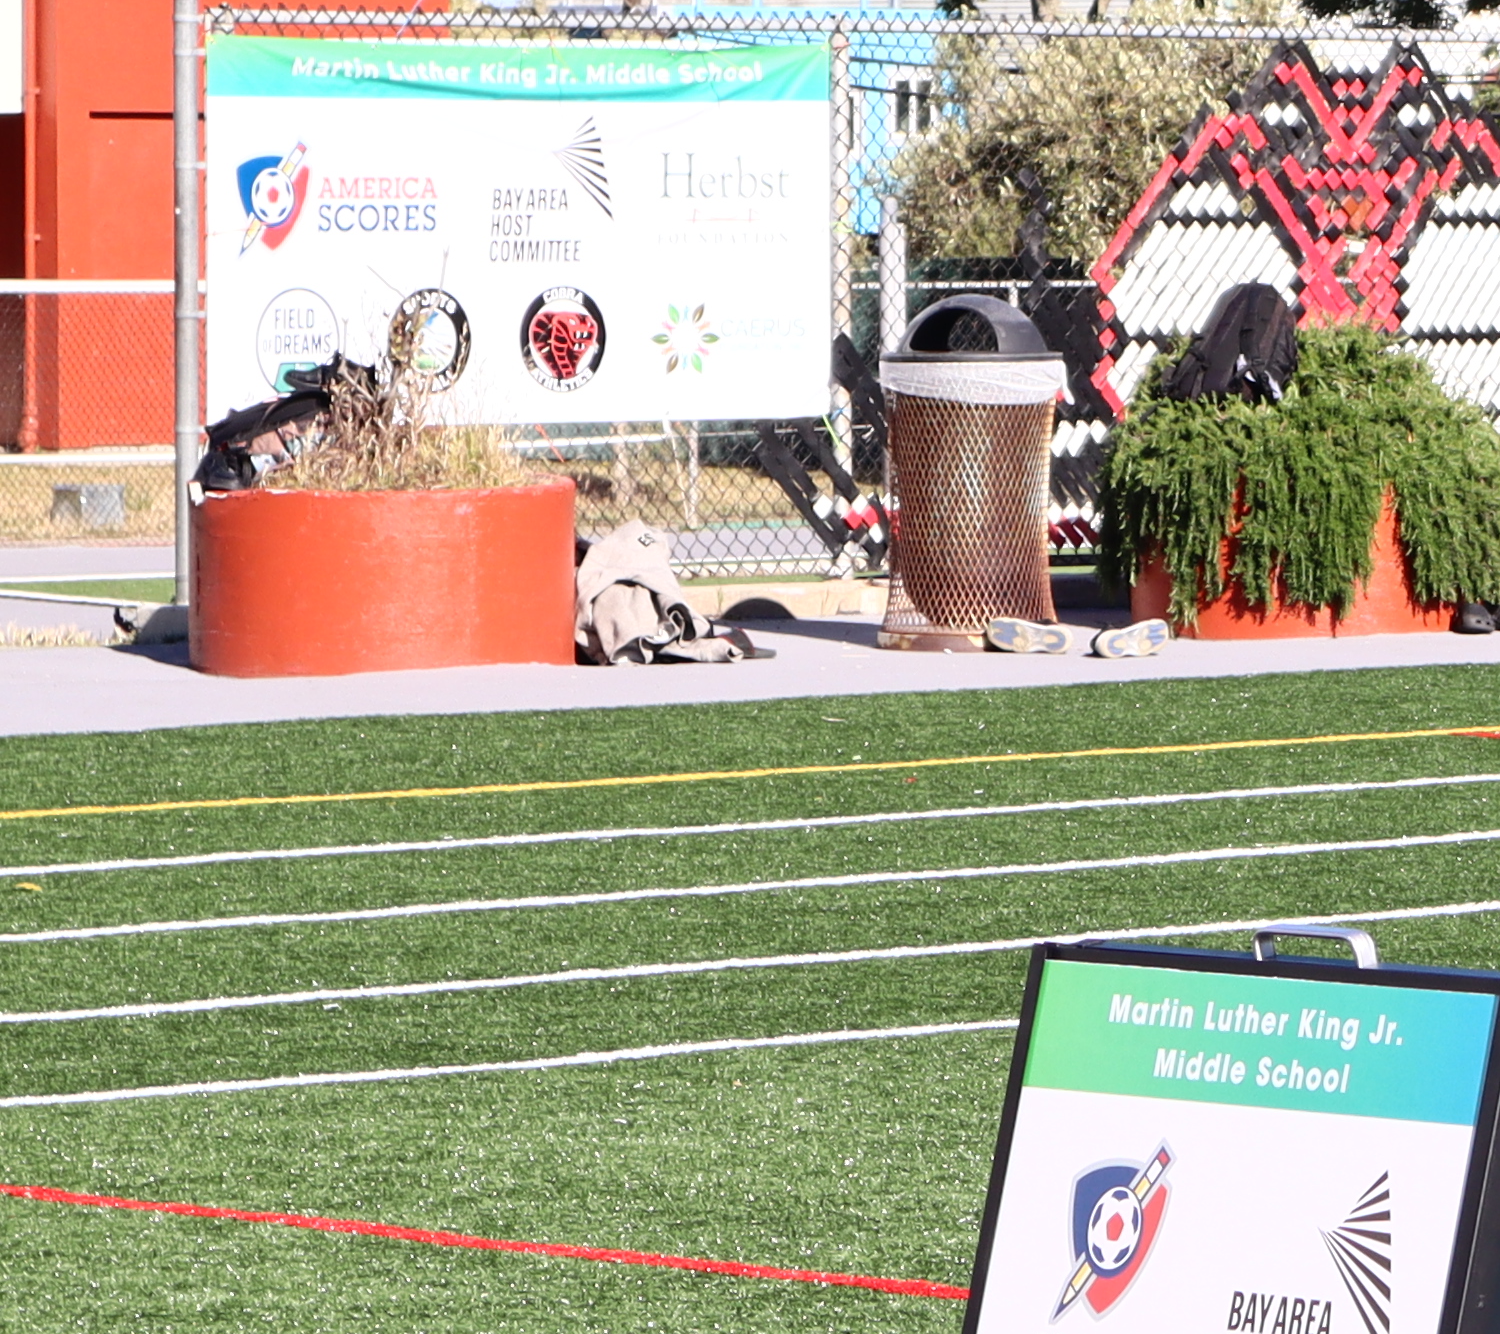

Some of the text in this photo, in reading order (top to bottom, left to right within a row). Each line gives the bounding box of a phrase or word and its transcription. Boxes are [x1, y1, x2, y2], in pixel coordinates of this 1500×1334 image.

[291, 56, 764, 88] Martin Luther King Jr. Middle School
[659, 152, 790, 199] Herbst
[318, 177, 438, 200] AMERICA
[318, 204, 437, 232] SCORES
[491, 214, 534, 237] HOST
[488, 239, 581, 263] COMMITTEE
[541, 287, 585, 305] COBRA
[275, 309, 315, 329] FIELD
[720, 318, 806, 339] CAERUS
[275, 333, 331, 355] DREAMS
[531, 368, 594, 393] ATHLETICS
[1108, 993, 1404, 1051] Martin Luther King Jr.
[1153, 1047, 1350, 1095] Middle School
